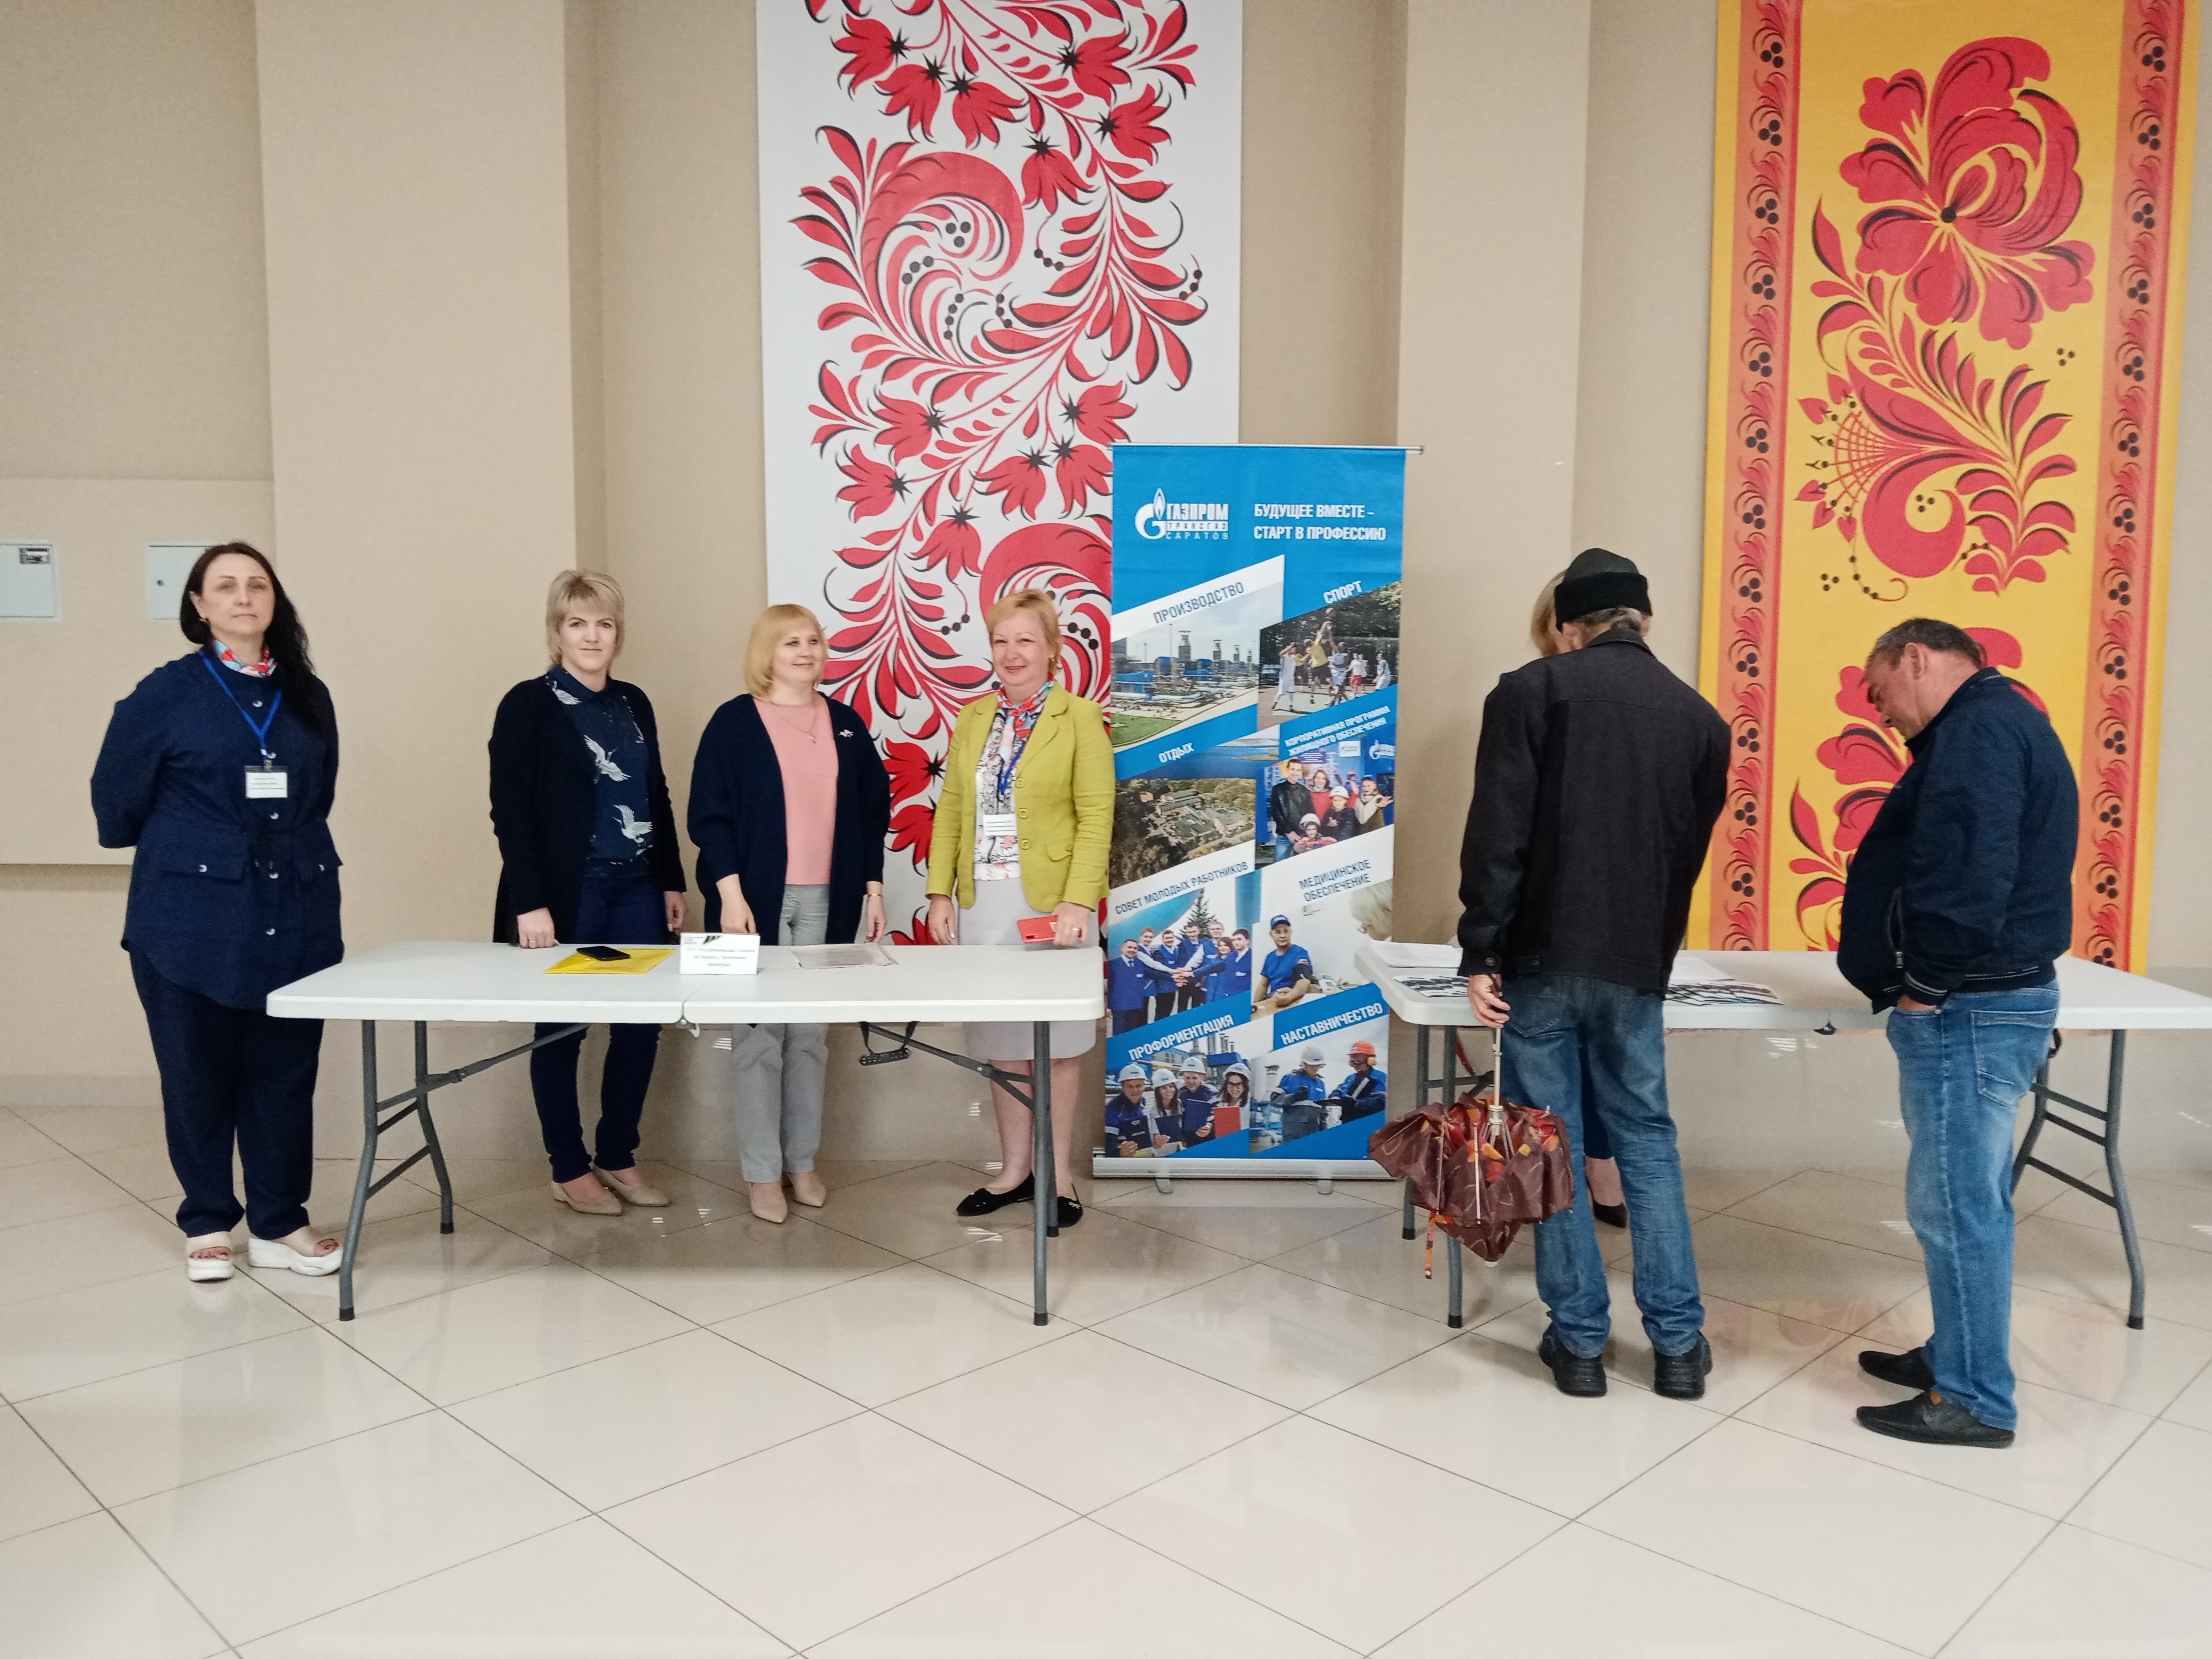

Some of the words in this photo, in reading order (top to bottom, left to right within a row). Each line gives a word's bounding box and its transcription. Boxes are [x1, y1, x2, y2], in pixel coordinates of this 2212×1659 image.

[1166, 504, 1229, 520] ГАЗПРОМ
[1254, 504, 1314, 519] БУДУЩЕЕ
[1316, 505, 1365, 518] ВМЕСТЕ
[1165, 532, 1229, 540] САРАТОВ
[1253, 526, 1293, 539] СТАРТ
[1295, 526, 1304, 539] В
[1306, 526, 1387, 541] ПРОФЕССИЮ
[1153, 582, 1244, 623] ПРОИЗВОДСТВО
[1323, 580, 1362, 604] СПОРТ
[1158, 742, 1195, 763] ОТДЫХ
[1299, 859, 1371, 889] МЕДИЦИНСКОЕ
[1304, 873, 1371, 901] ОБЕСПЕЧЕНИЕ
[1115, 898, 1142, 914] СОВЕТ
[1144, 880, 1191, 904] МОЛОДЫХ
[1191, 861, 1248, 887] РАБОТНИКОВ
[1280, 1003, 1383, 1045] НАСТАВНИЧЕСТВО
[1128, 1015, 1234, 1060] ПРОФОРИЕНТАЦИЯ
